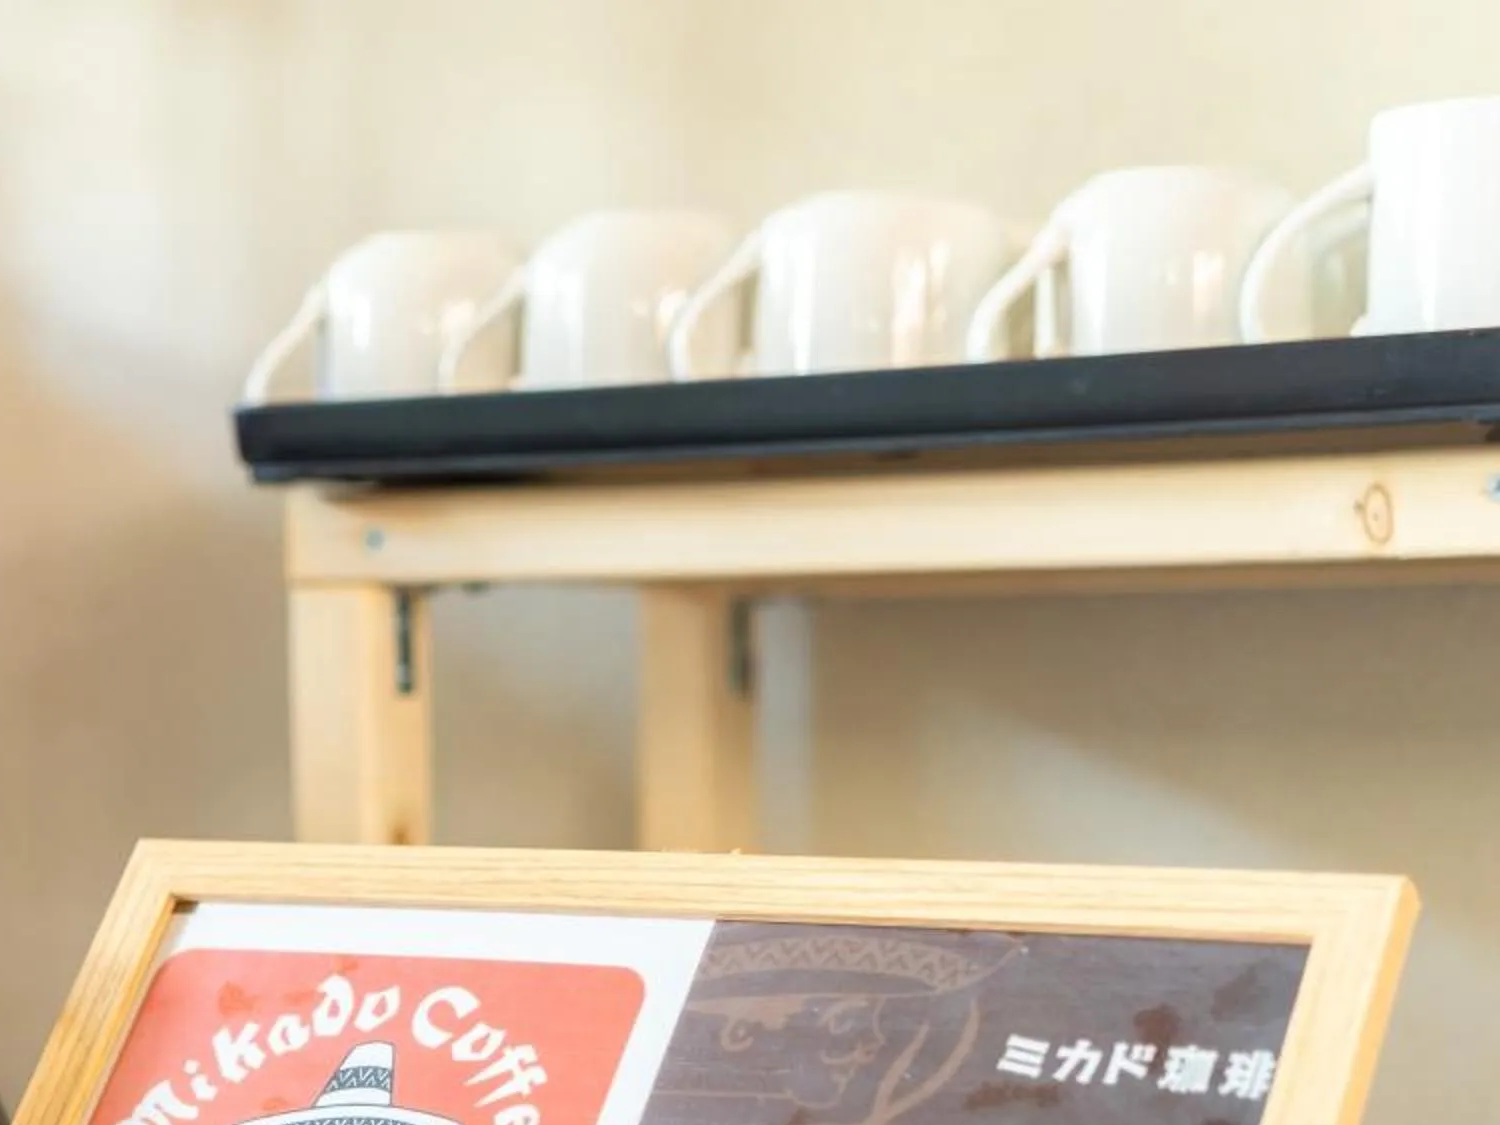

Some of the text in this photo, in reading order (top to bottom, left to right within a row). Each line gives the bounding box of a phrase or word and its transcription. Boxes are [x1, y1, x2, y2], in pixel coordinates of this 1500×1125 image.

[997, 1033, 1277, 1100] ミカド珈琲
